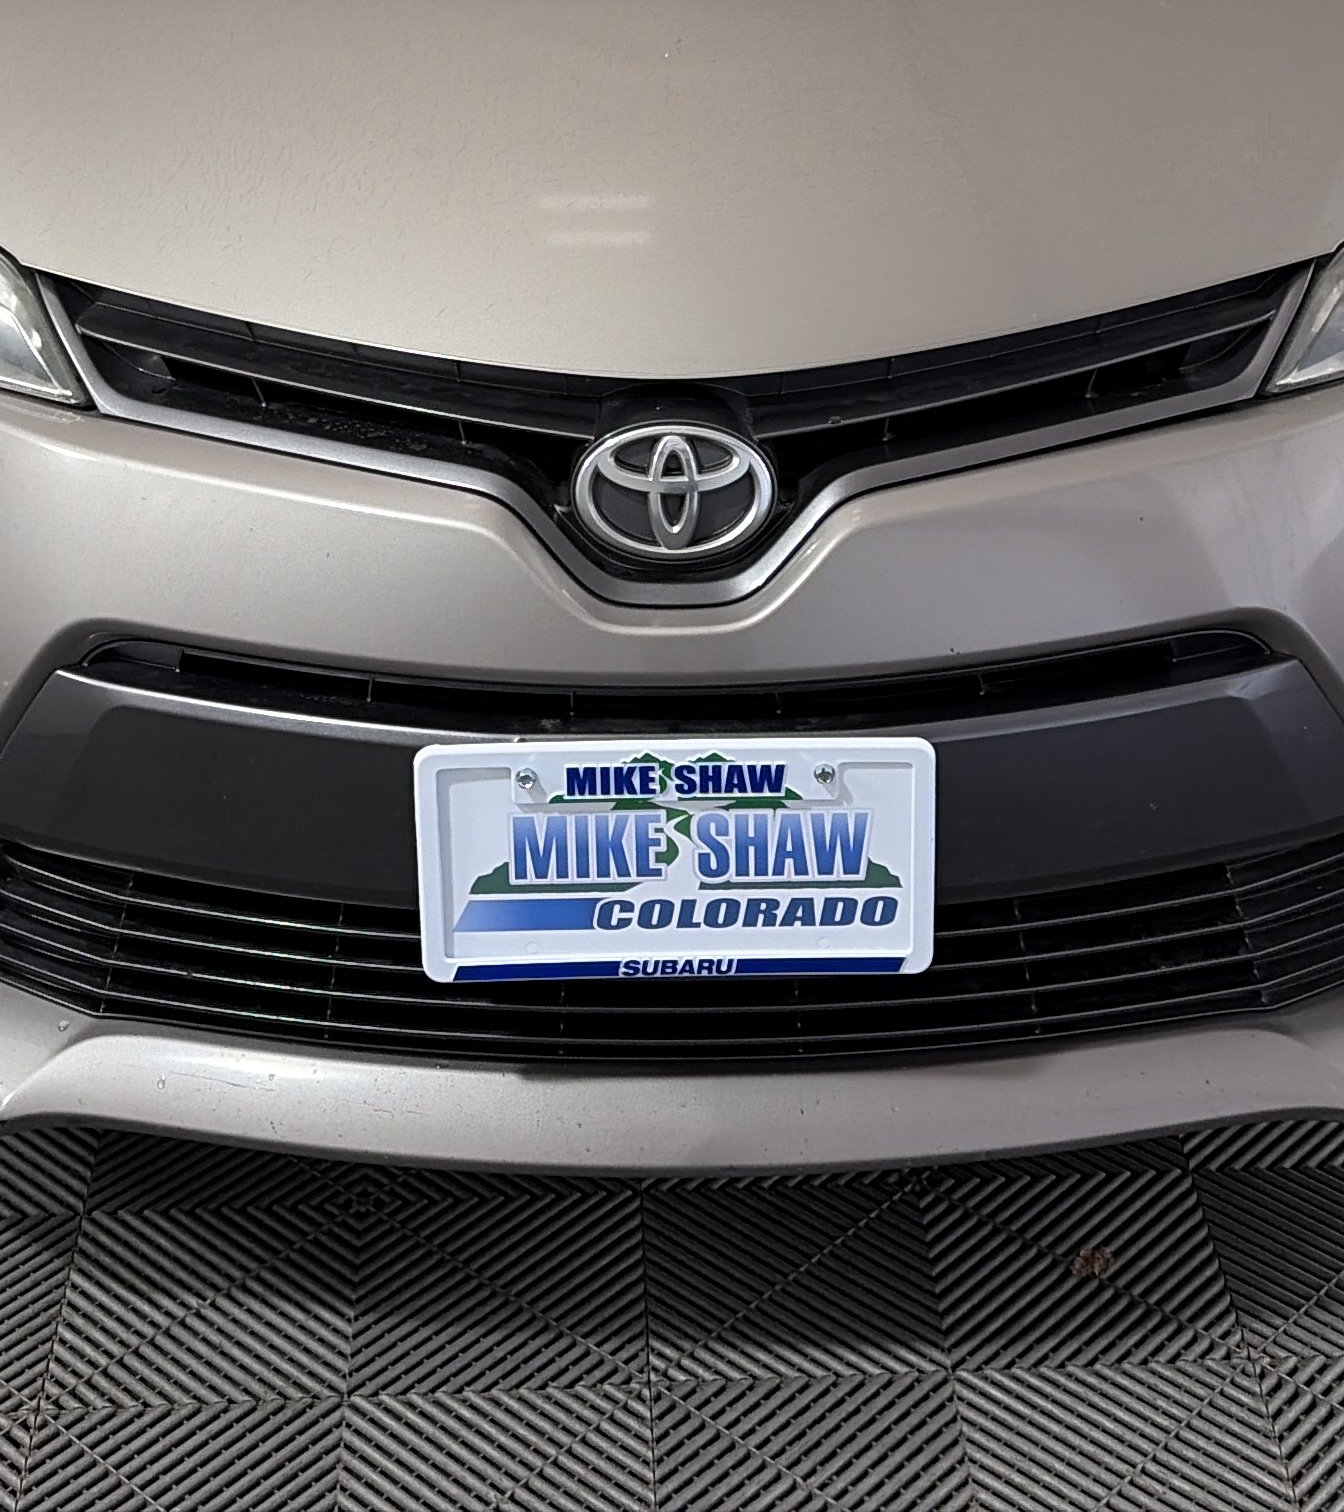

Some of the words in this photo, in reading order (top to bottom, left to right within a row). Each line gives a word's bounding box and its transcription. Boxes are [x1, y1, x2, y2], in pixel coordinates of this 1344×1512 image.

[565, 766, 657, 796] MIKE
[674, 763, 786, 796] SHAW
[512, 813, 664, 880] MIKE
[696, 811, 870, 879] SHAW
[596, 895, 899, 931] COLORADO
[621, 958, 735, 977] SUBARU
